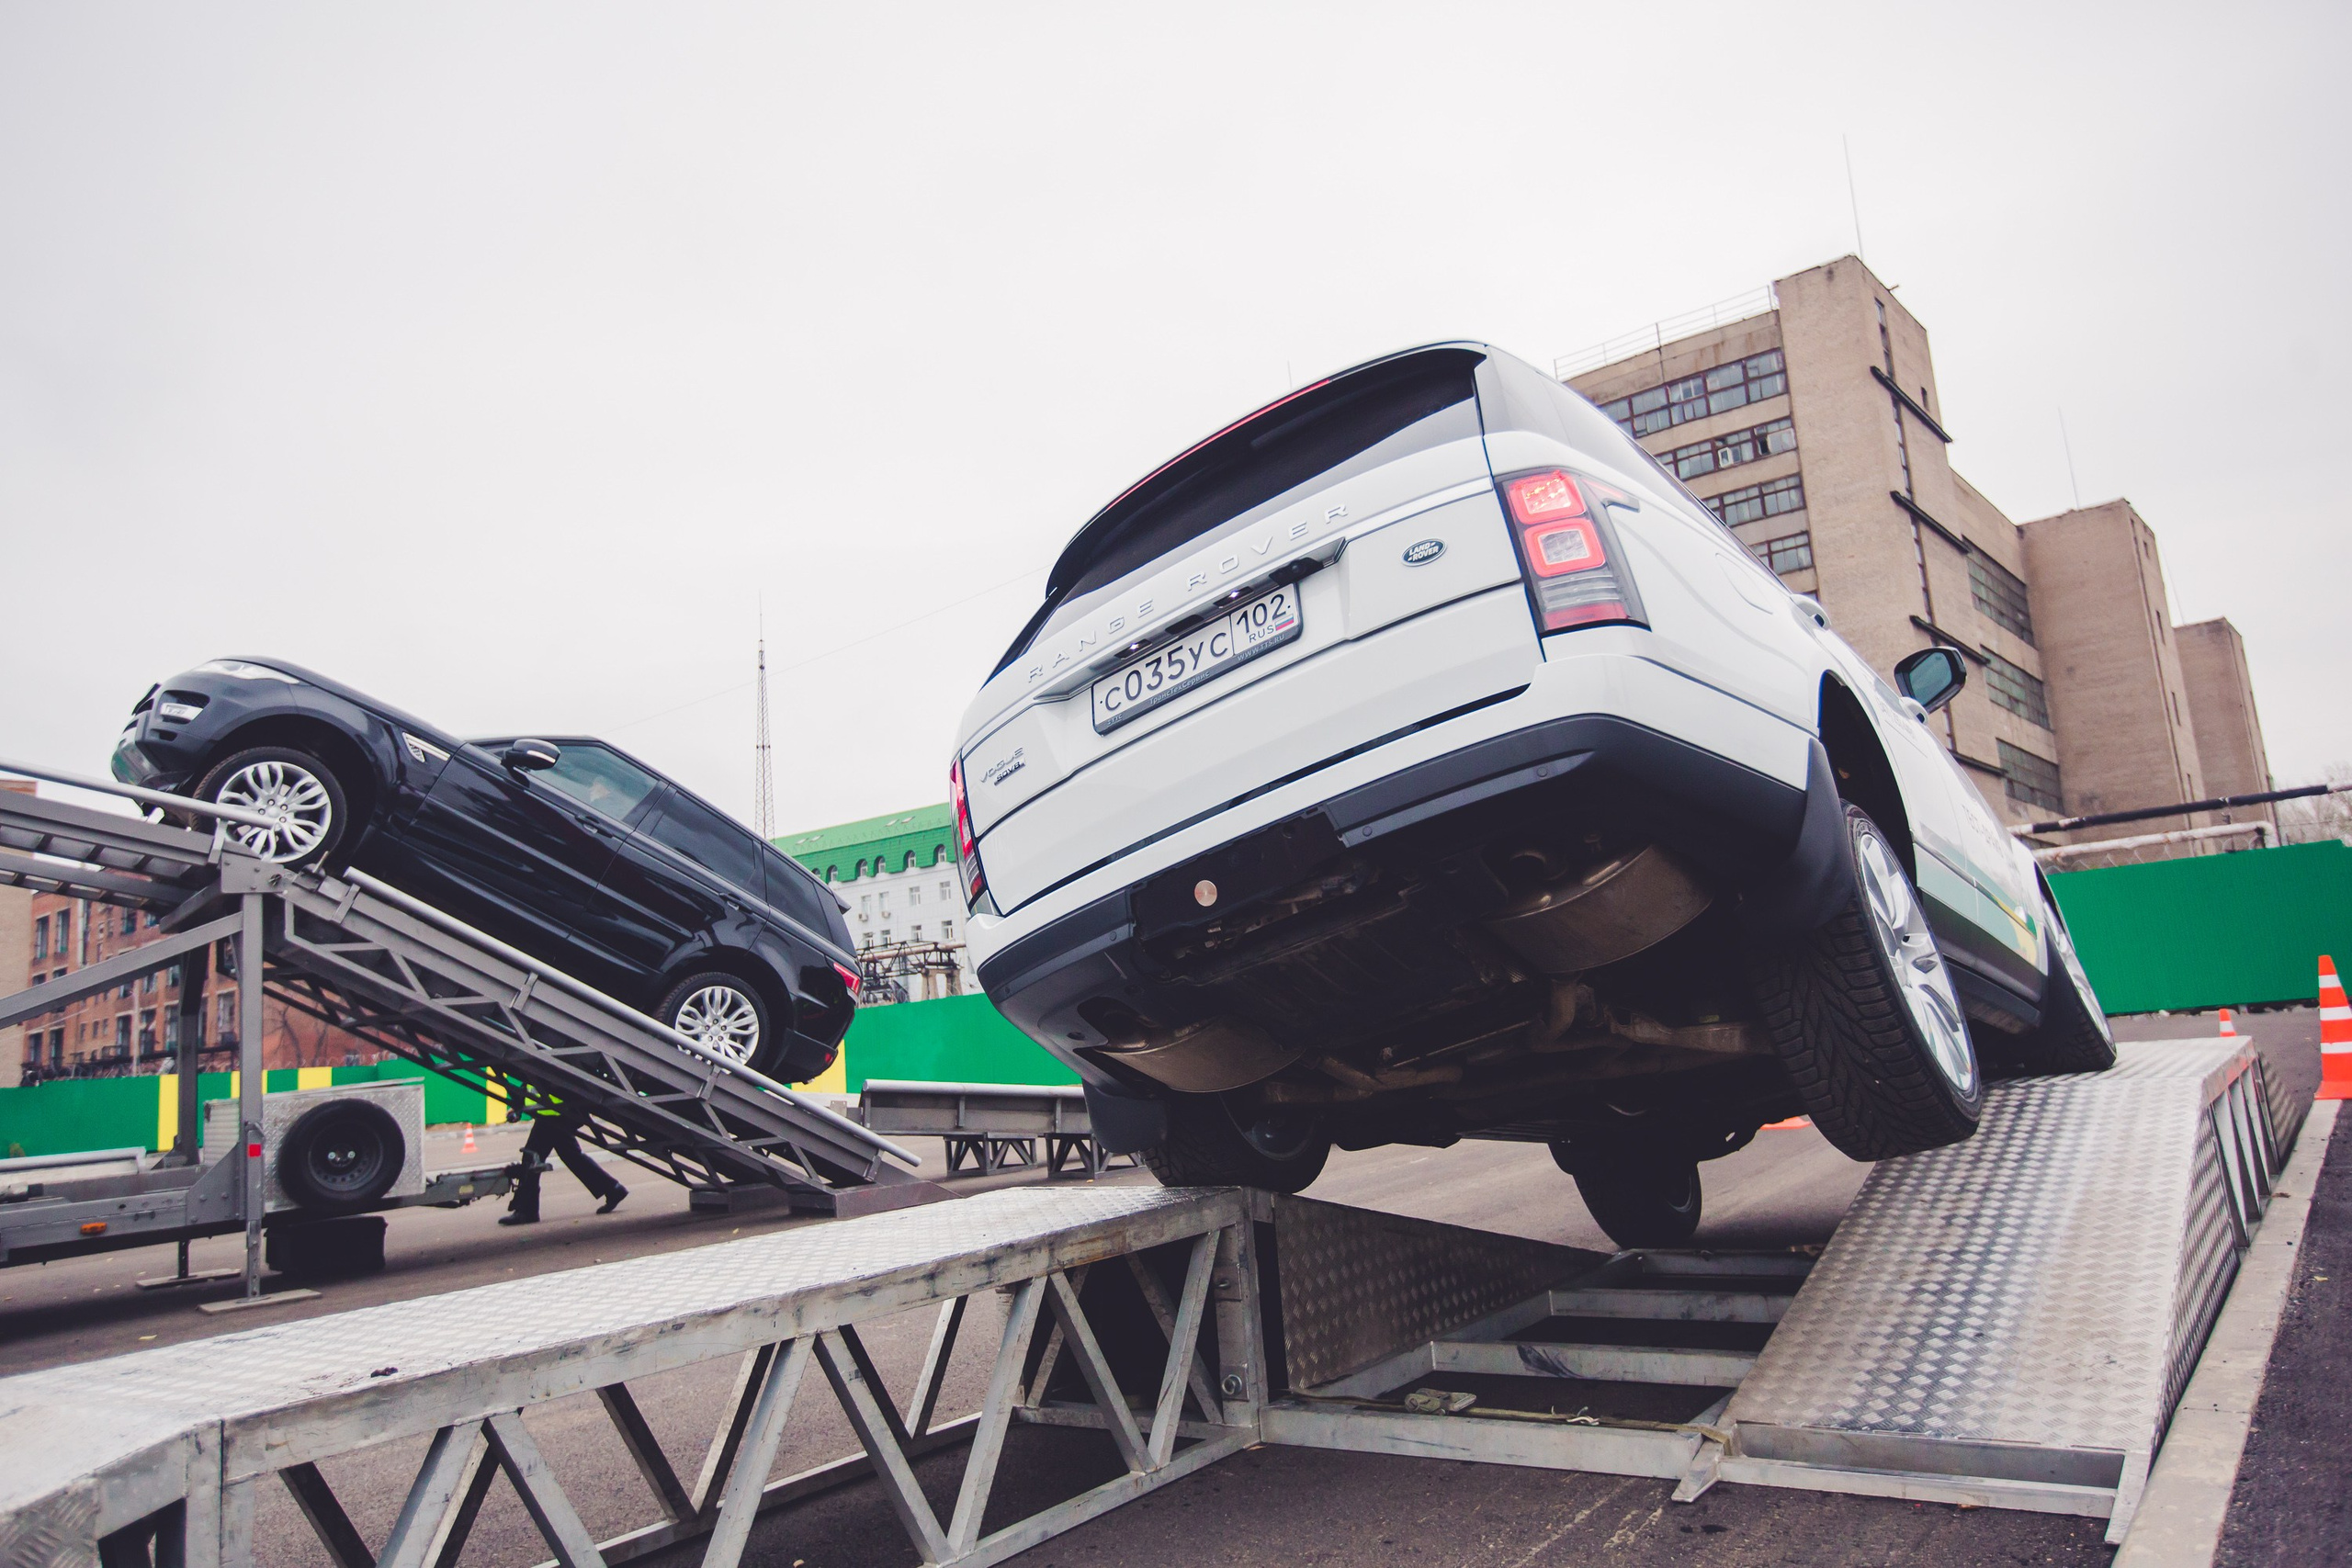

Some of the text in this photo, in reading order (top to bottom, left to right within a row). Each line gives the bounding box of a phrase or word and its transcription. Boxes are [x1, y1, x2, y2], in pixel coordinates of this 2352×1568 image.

[1408, 542, 1431, 557] LAND
[1412, 546, 1440, 562] ROVER
[1027, 503, 1349, 683] RANGE ROVER
[1236, 593, 1286, 634] 102
[1237, 634, 1285, 661] WWW.TTS.RU
[1249, 625, 1274, 644] RUS
[1149, 671, 1211, 705] ТрансТехСервис
[979, 747, 1024, 784] VOGUE
